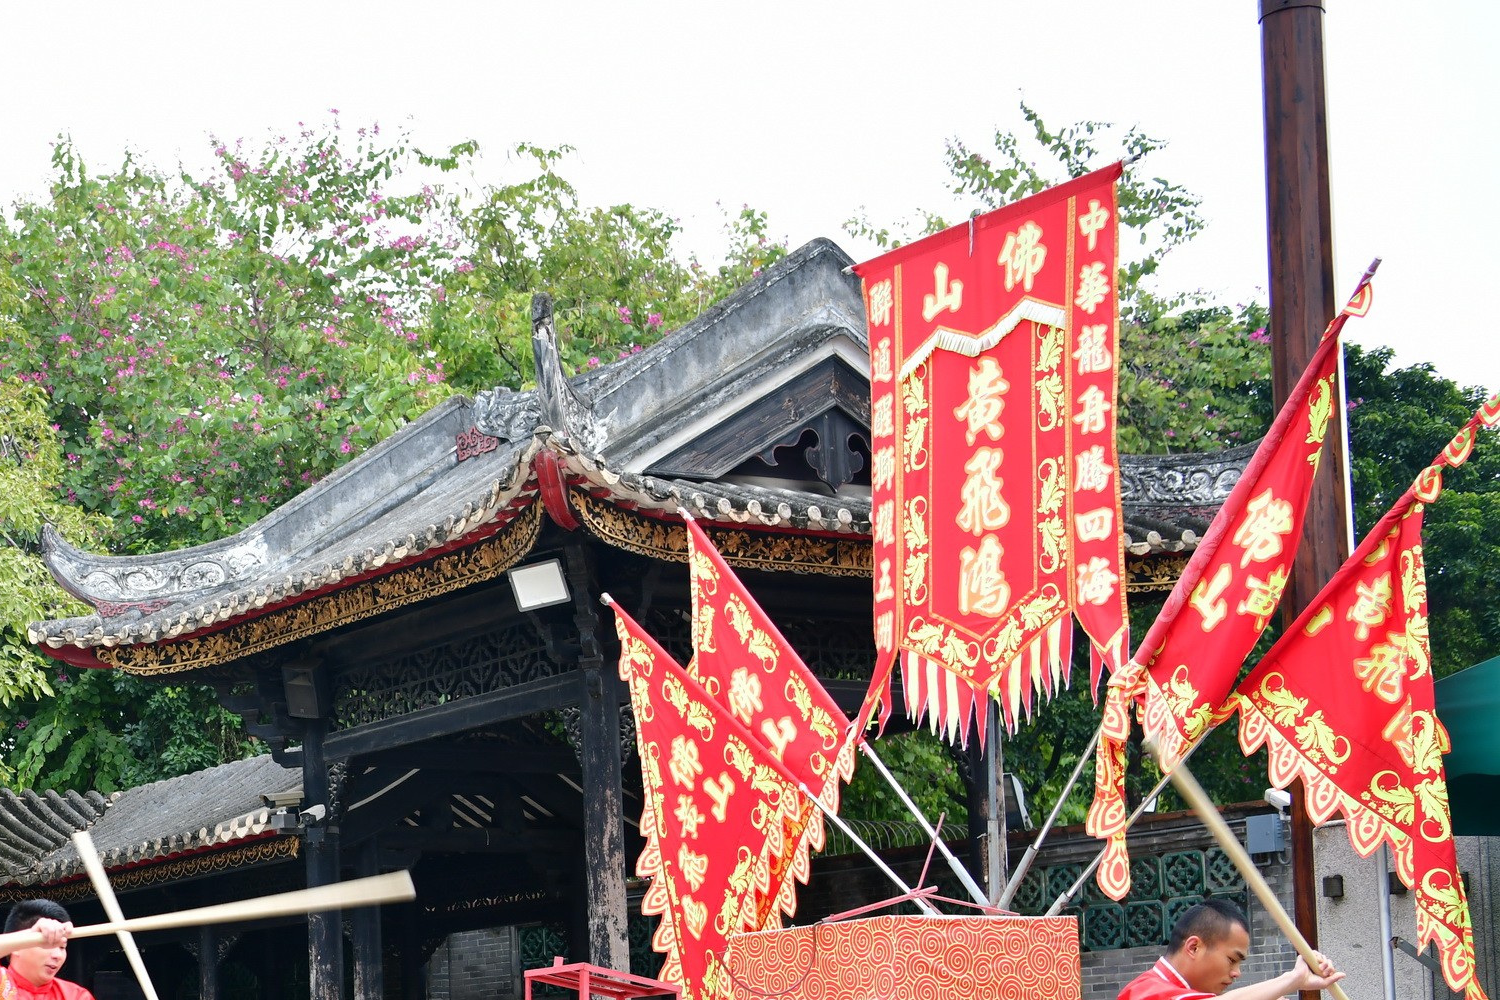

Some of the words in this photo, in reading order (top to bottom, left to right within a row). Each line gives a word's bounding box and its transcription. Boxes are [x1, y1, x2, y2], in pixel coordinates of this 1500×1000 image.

[922, 220, 1049, 323] 佛山
[1073, 199, 1120, 608] 中華龍舟騰四海
